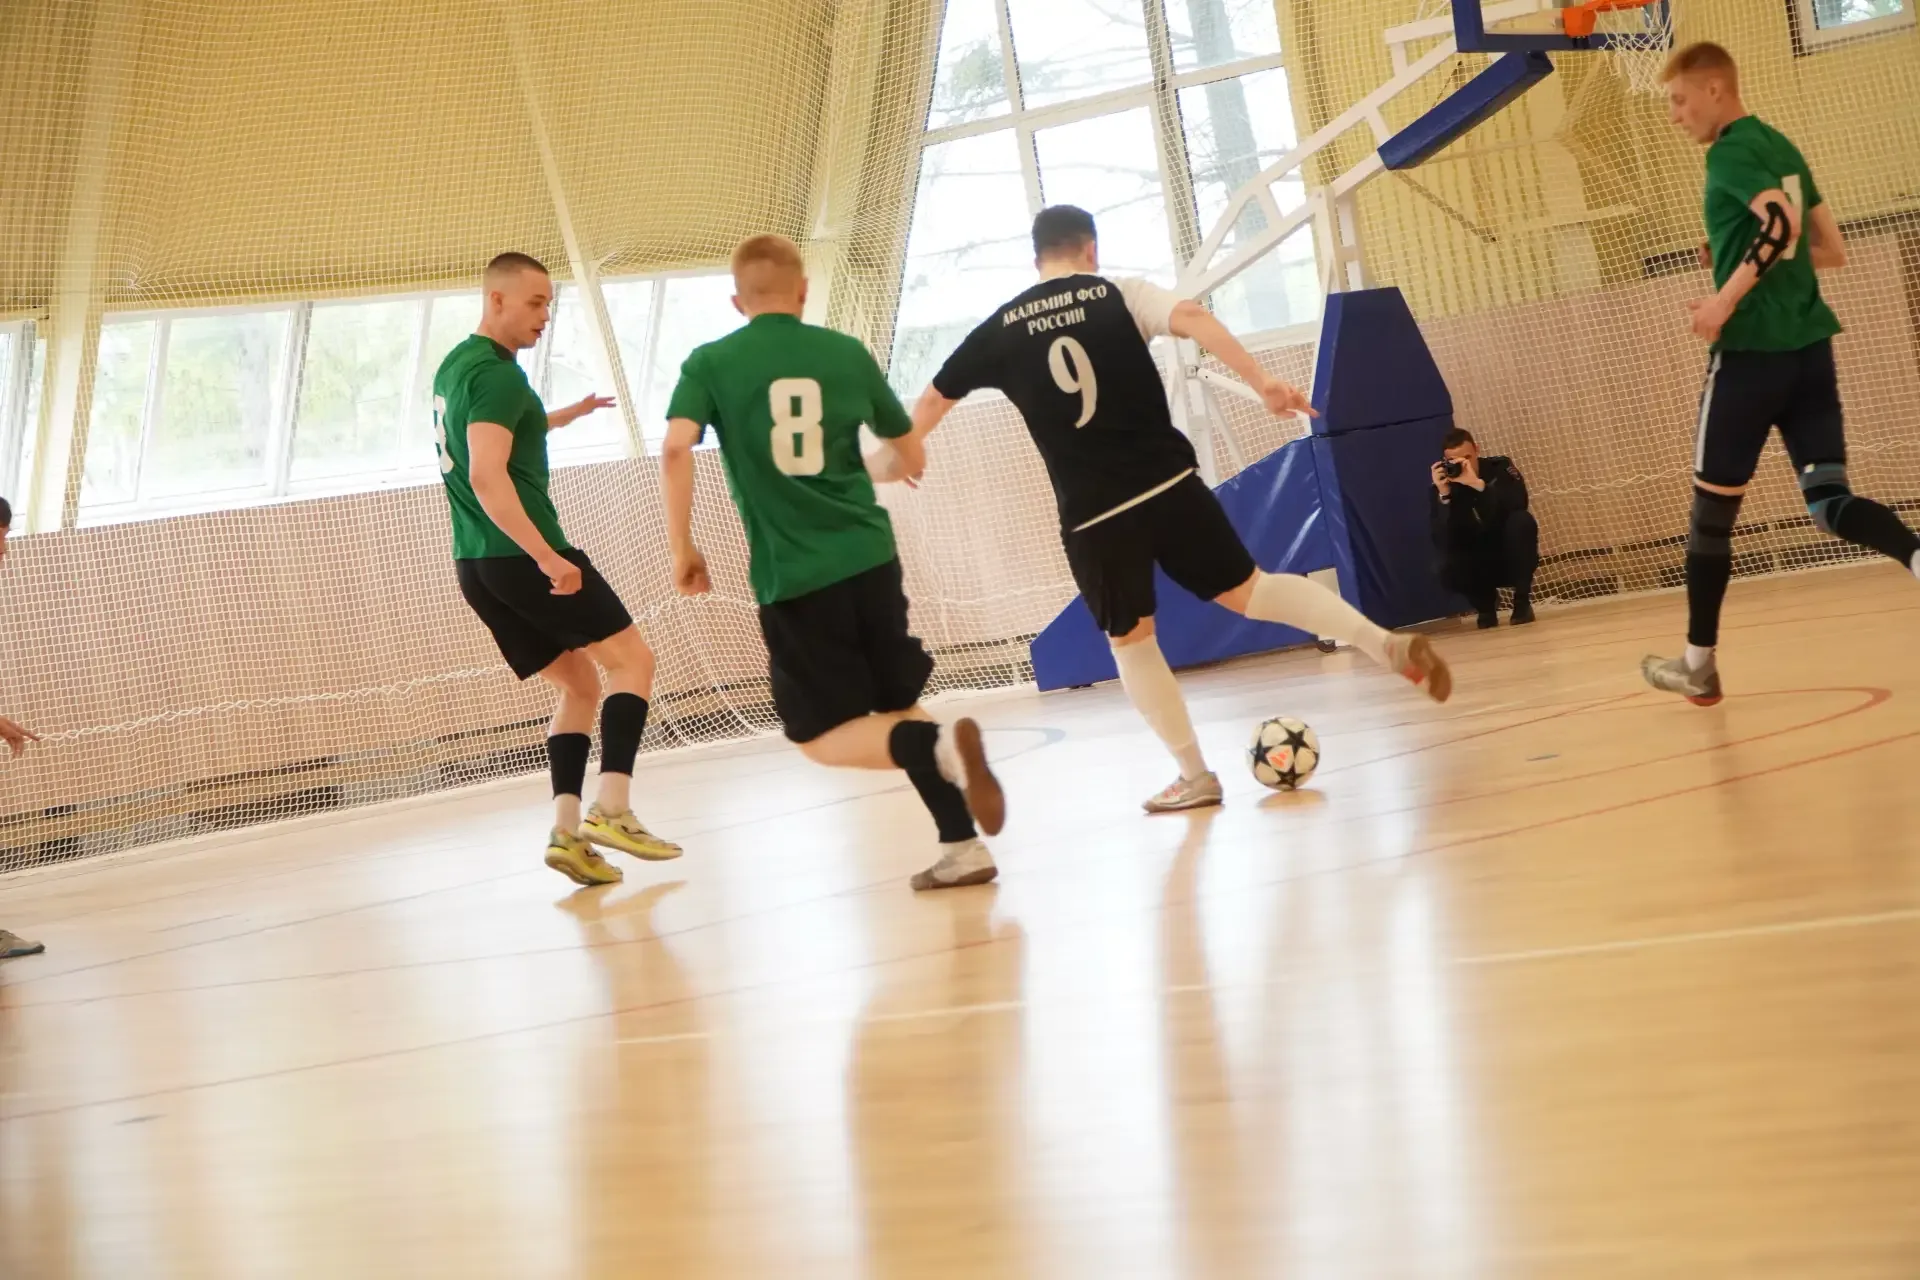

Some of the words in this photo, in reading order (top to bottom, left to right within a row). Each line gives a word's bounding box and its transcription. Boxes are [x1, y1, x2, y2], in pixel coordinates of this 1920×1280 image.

[1003, 290, 1074, 327] АКАДЕМИЯ
[1076, 284, 1108, 302] ФСО
[1027, 307, 1086, 336] РОССИИ
[1048, 336, 1098, 429] 9
[768, 377, 825, 476] 8
